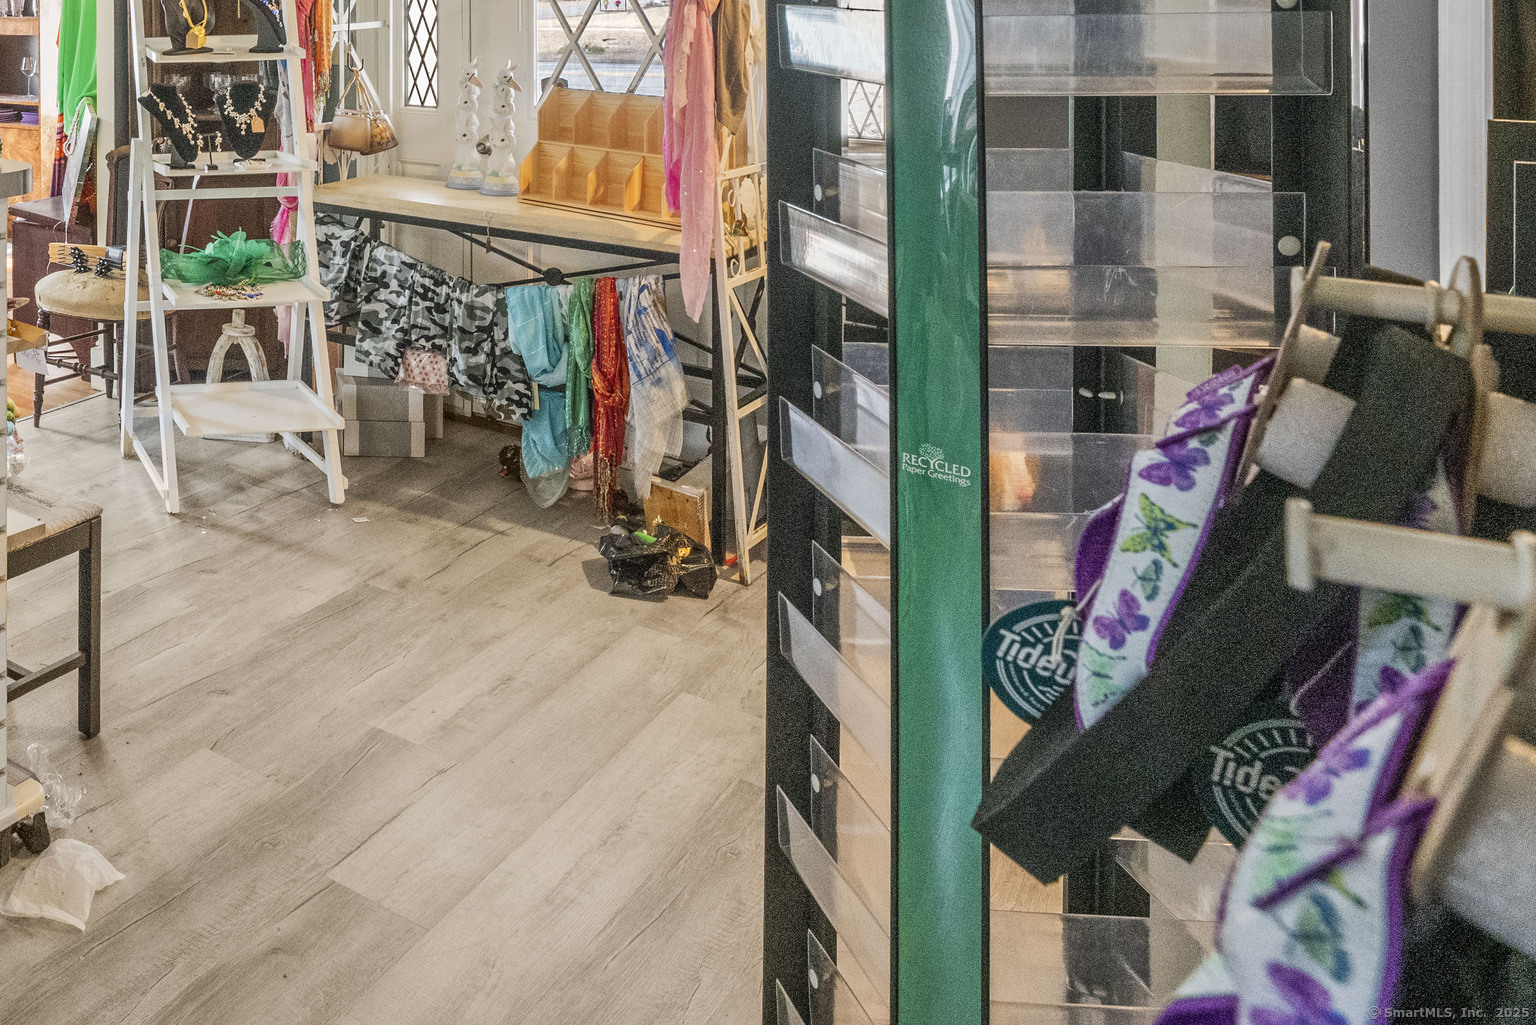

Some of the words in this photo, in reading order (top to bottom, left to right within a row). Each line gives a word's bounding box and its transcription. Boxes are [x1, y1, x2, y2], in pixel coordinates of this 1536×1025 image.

[902, 452, 971, 477] RECYCLED
[902, 463, 925, 475] Paper
[927, 470, 971, 487] Greetings
